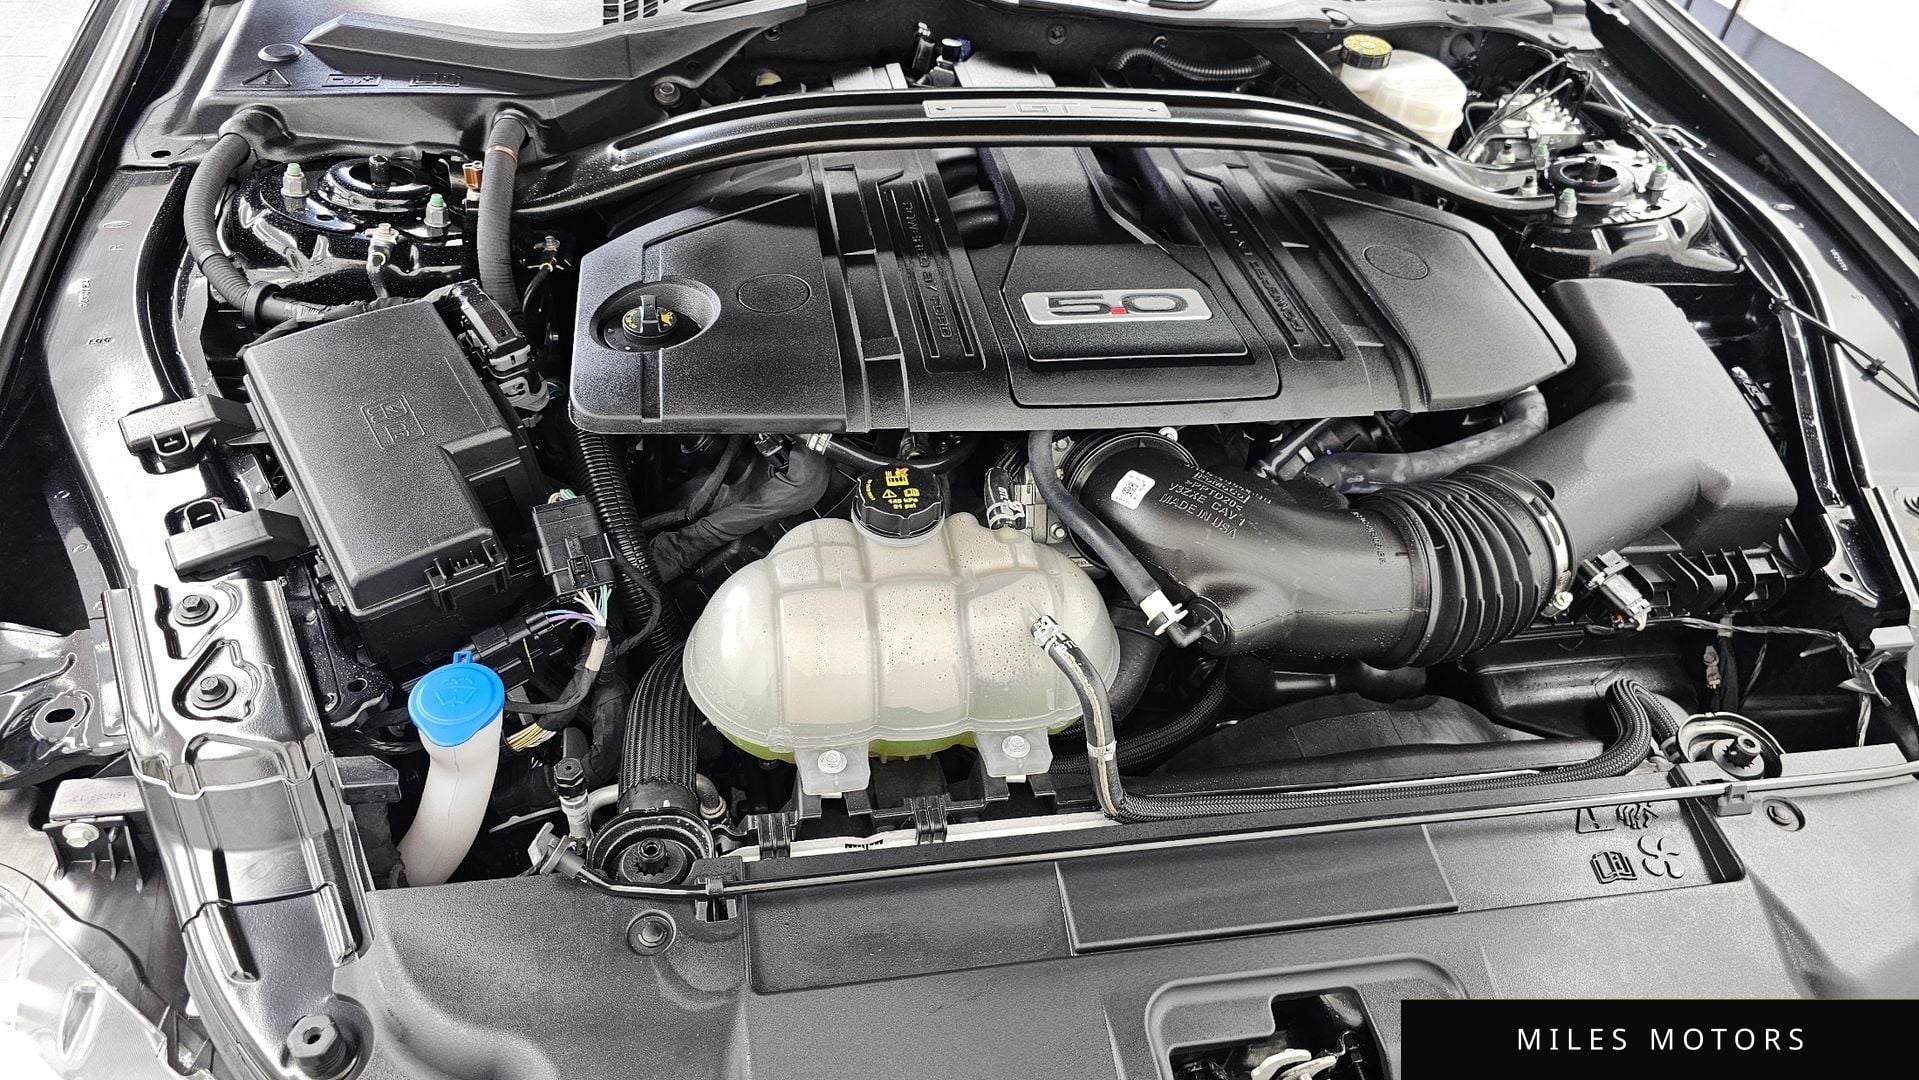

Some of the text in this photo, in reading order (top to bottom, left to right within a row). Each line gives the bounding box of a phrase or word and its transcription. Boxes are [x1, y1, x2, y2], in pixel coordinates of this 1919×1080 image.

[1014, 101, 1079, 115] GT
[929, 295, 954, 339] FORD
[1046, 293, 1189, 316] 5.0
[1159, 492, 1238, 540] MADE IN USA
